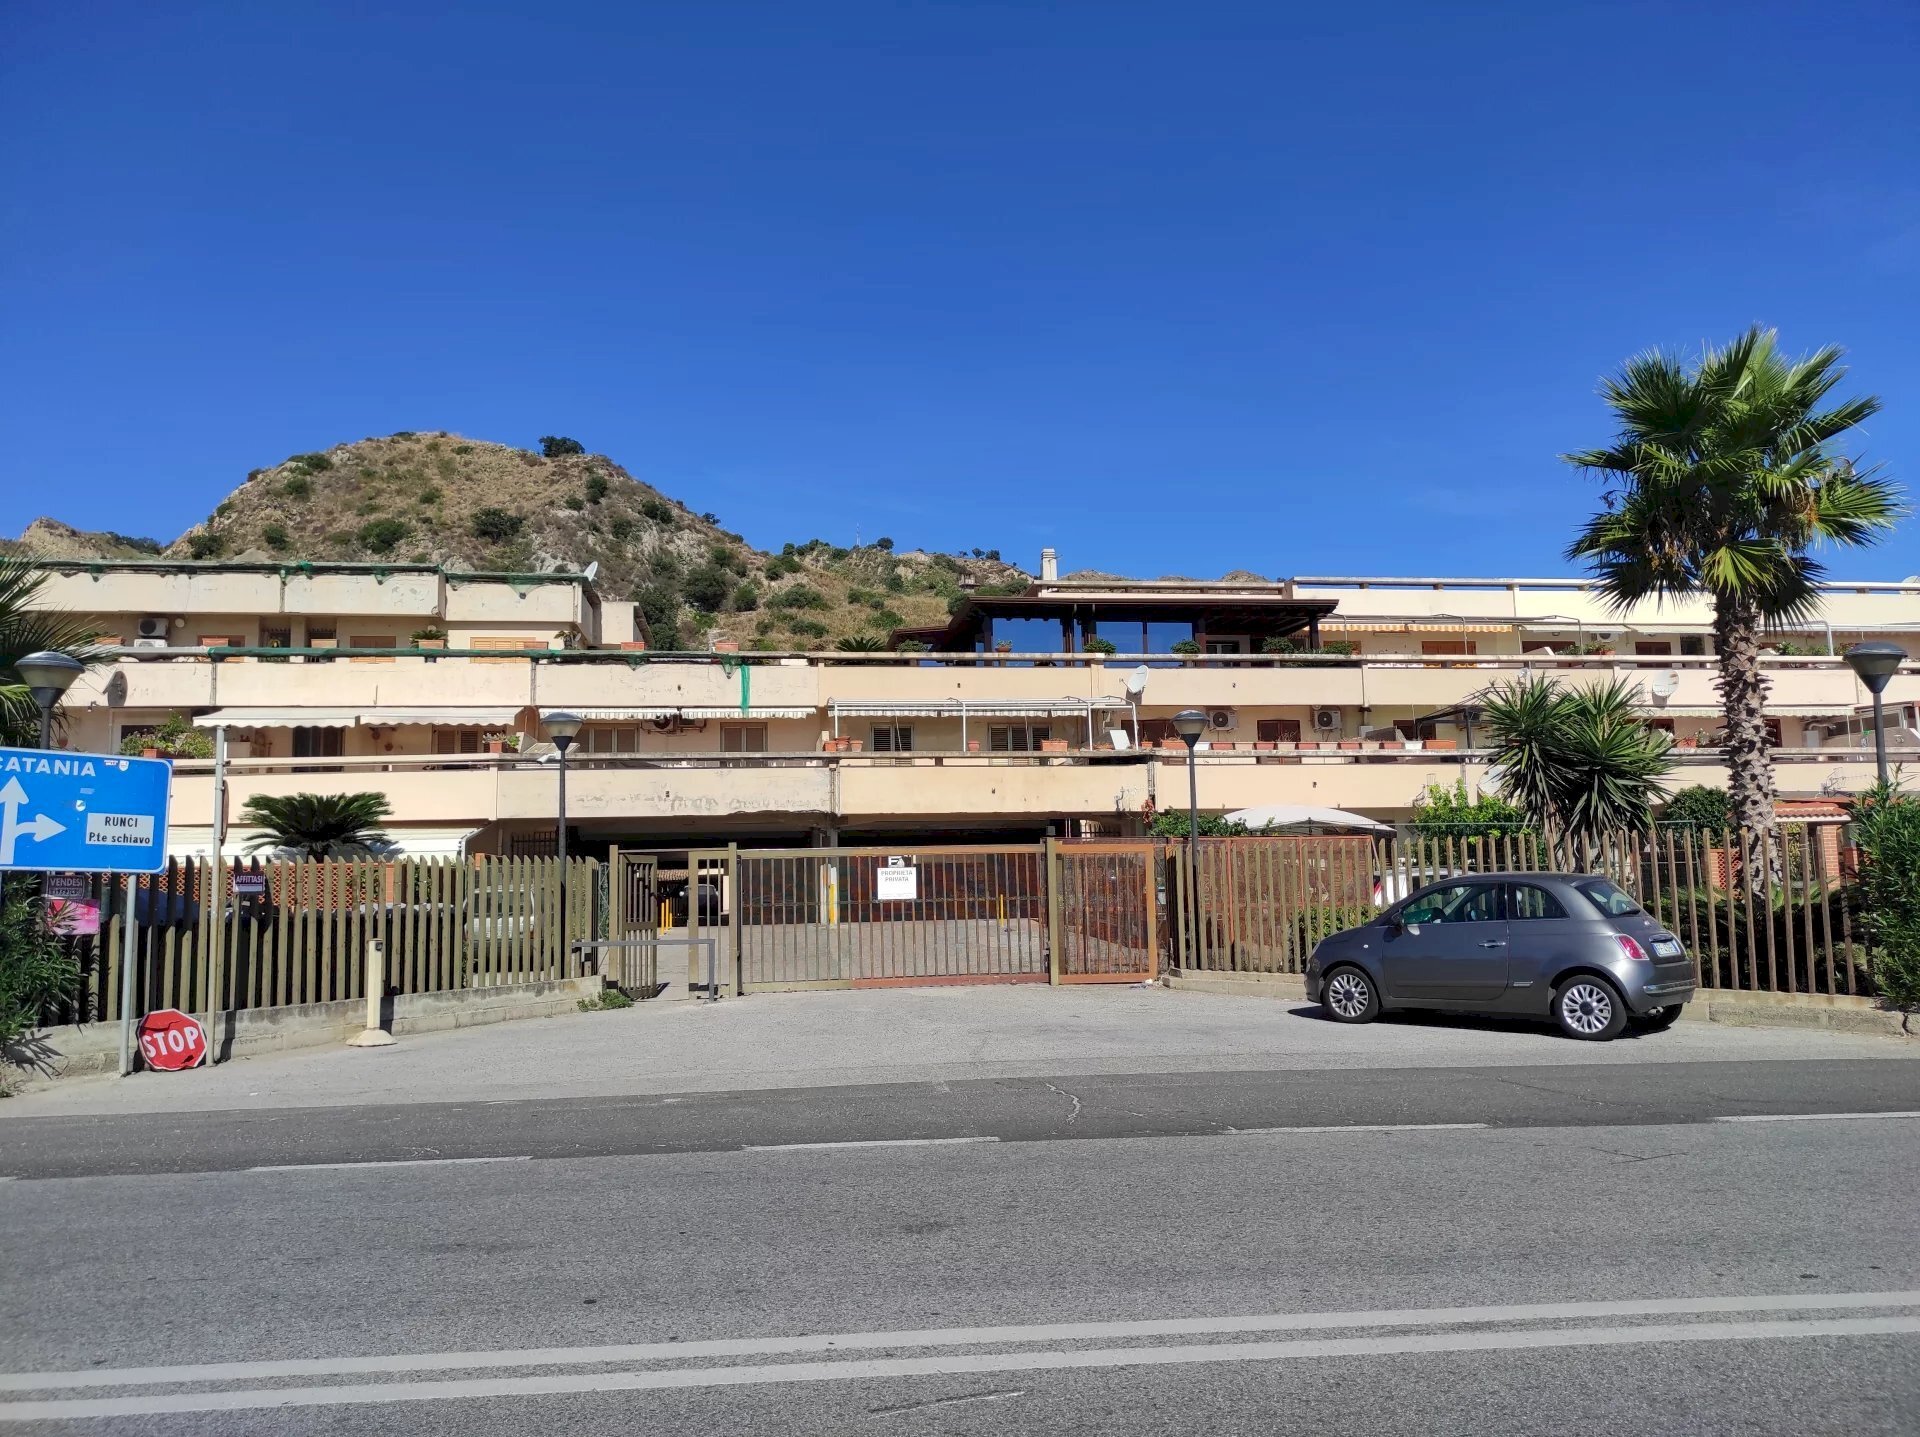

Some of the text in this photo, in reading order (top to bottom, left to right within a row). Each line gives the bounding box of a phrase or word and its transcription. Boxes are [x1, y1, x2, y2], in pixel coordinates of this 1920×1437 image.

[0, 756, 96, 777] ATANIA
[104, 816, 138, 828] RUNCI
[88, 832, 150, 844] P.te schiavo
[50, 877, 83, 887] VENDESI
[236, 875, 263, 883] AFFITTASI
[142, 1026, 199, 1058] STOP
